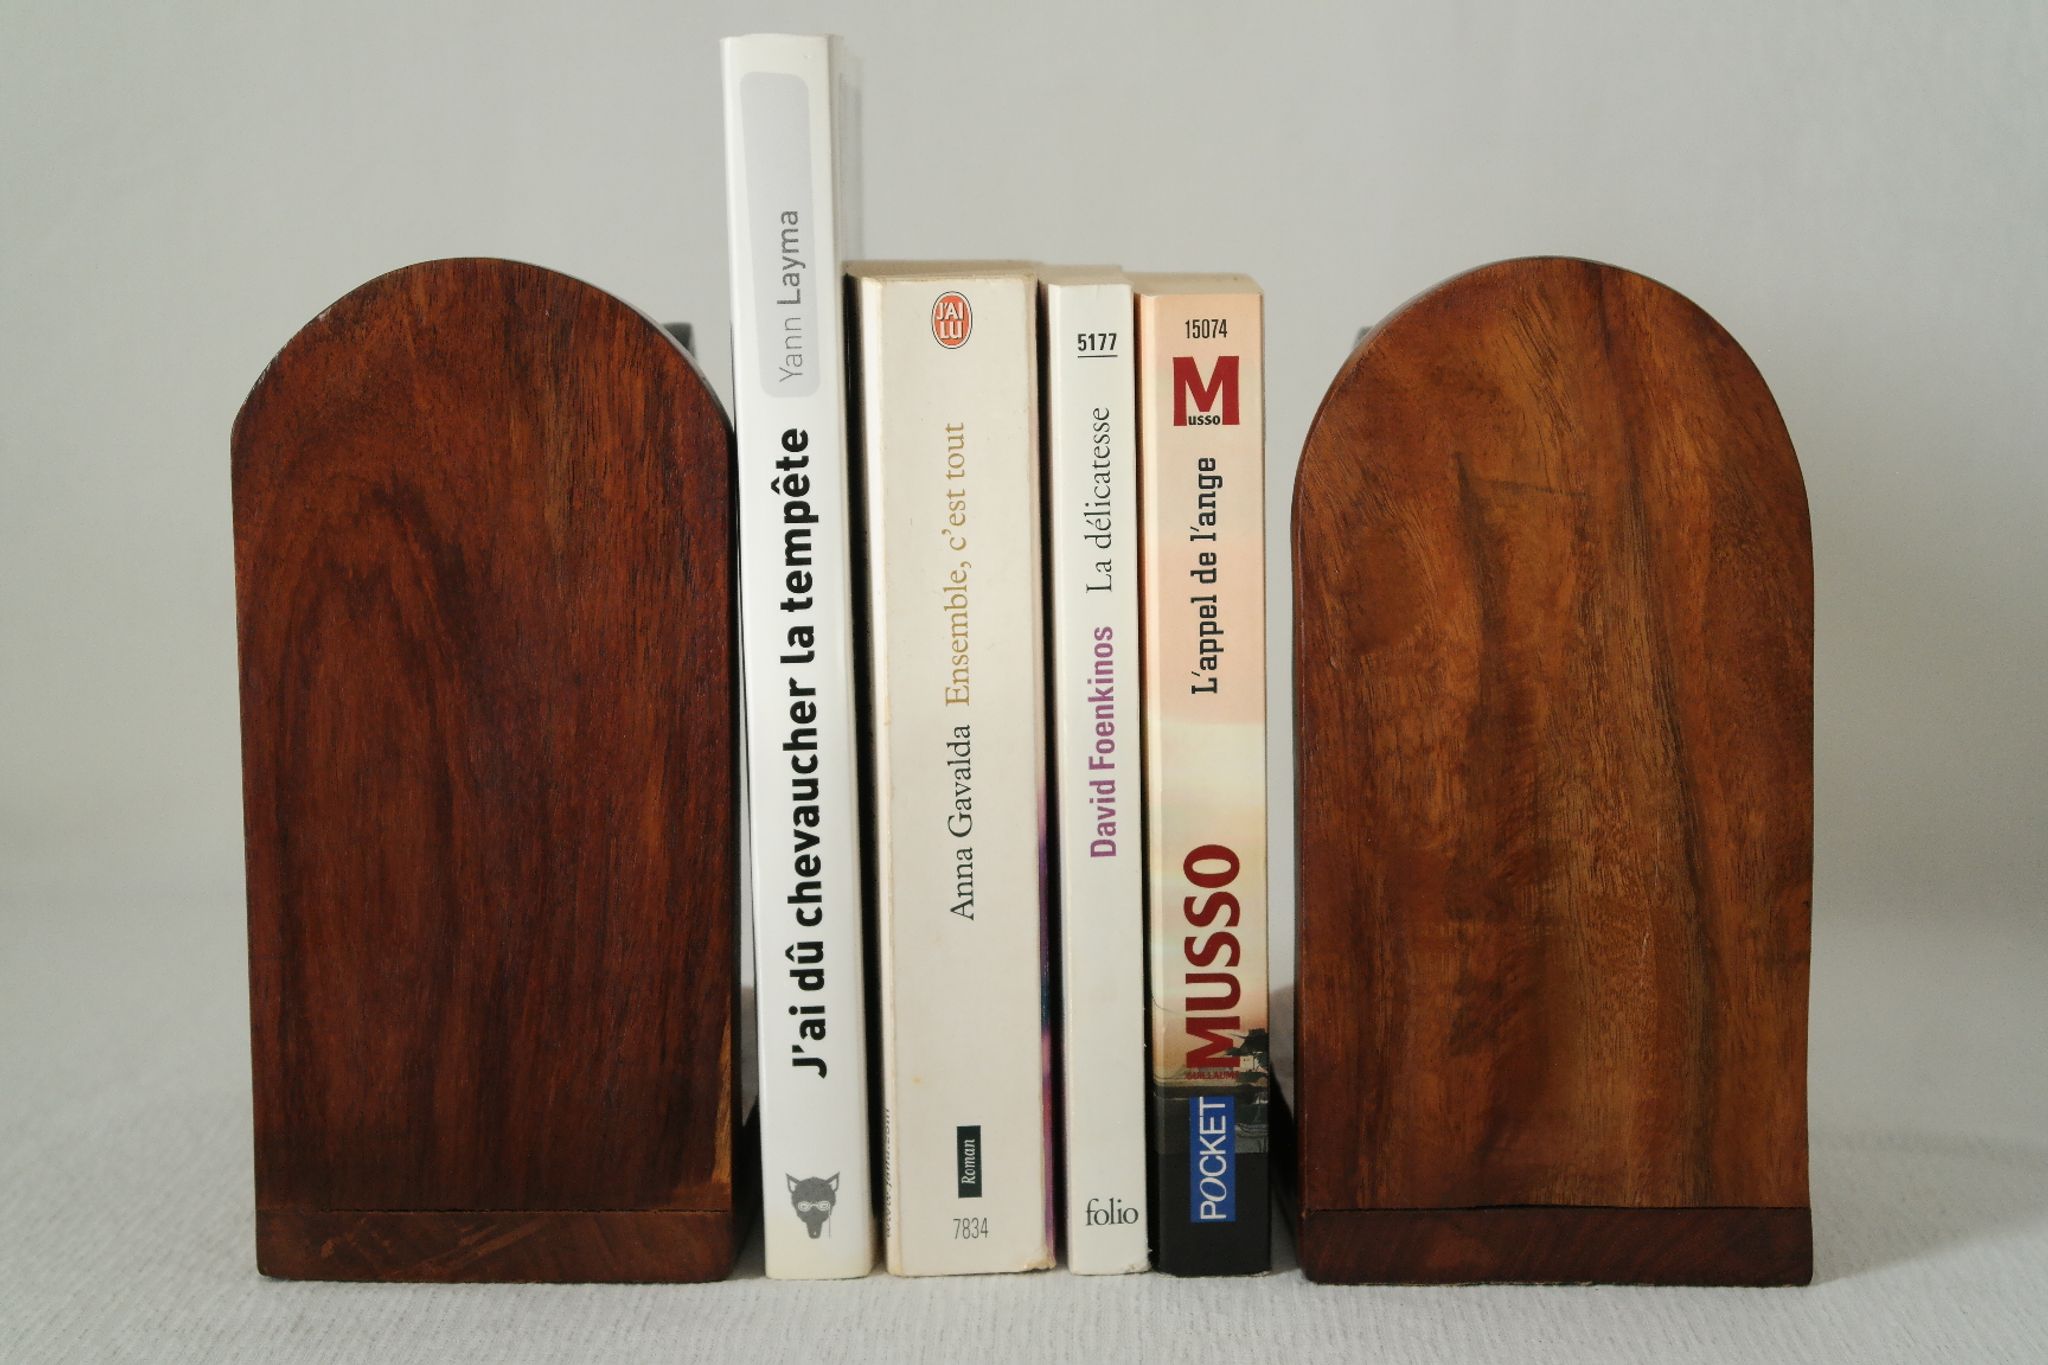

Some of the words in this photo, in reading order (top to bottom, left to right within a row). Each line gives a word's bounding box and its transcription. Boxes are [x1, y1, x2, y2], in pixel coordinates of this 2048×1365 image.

[777, 211, 806, 304] Layma
[936, 302, 964, 320] J'AI
[940, 321, 963, 339] LU
[1078, 333, 1117, 351] 5177
[1185, 319, 1227, 339] 15074
[779, 318, 803, 382] Yann
[945, 423, 965, 480] tout
[1084, 408, 1111, 549] délicatesse
[771, 429, 819, 612] tempête
[941, 488, 966, 551] c'est
[1190, 458, 1223, 541] l'ange
[1086, 559, 1111, 591] La
[1190, 552, 1217, 584] de
[780, 626, 815, 663] la
[943, 561, 971, 706] Ensemble,
[1191, 594, 1224, 694] L'appel
[1087, 627, 1115, 770] Foenkinos
[783, 677, 822, 926] chevaucher
[946, 725, 972, 837] Gavalda
[1089, 780, 1116, 857] David
[950, 847, 974, 920] Anna
[785, 941, 824, 991] dû
[1183, 843, 1241, 1068] MUSSO
[789, 1006, 827, 1079] J'ai
[961, 1138, 976, 1184] Roman
[1199, 1097, 1226, 1219] POCKET
[953, 1217, 988, 1239] 7834
[1086, 1198, 1138, 1226] folio
